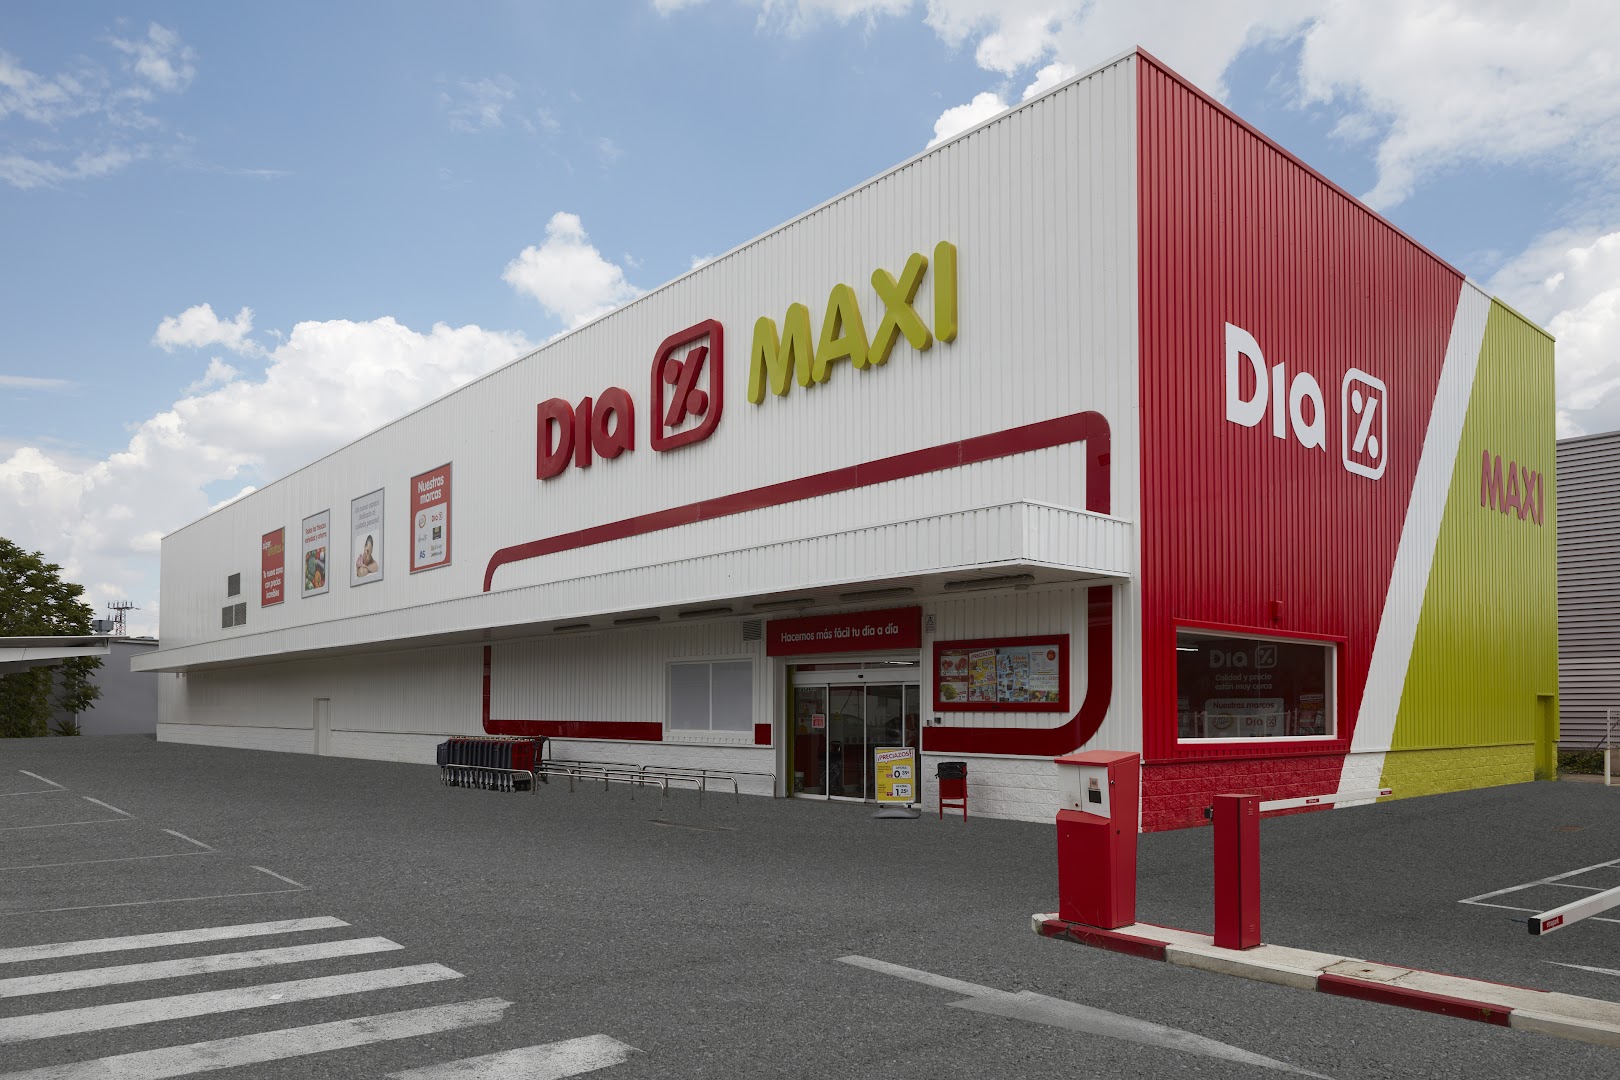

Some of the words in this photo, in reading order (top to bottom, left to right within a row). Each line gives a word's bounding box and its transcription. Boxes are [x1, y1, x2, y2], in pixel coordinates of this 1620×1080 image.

[747, 240, 958, 406] MAXI
[418, 475, 445, 493] Nuestras
[1480, 450, 1544, 527] MAXI
[420, 488, 442, 504] marcas
[781, 632, 815, 643] Hacemos
[816, 628, 832, 640] más
[834, 626, 850, 639] fácil
[852, 627, 860, 638] tu
[862, 624, 875, 637] día
[877, 627, 883, 635] a
[885, 623, 899, 635] día
[1215, 673, 1242, 681] Calidad
[1249, 673, 1272, 682] precio
